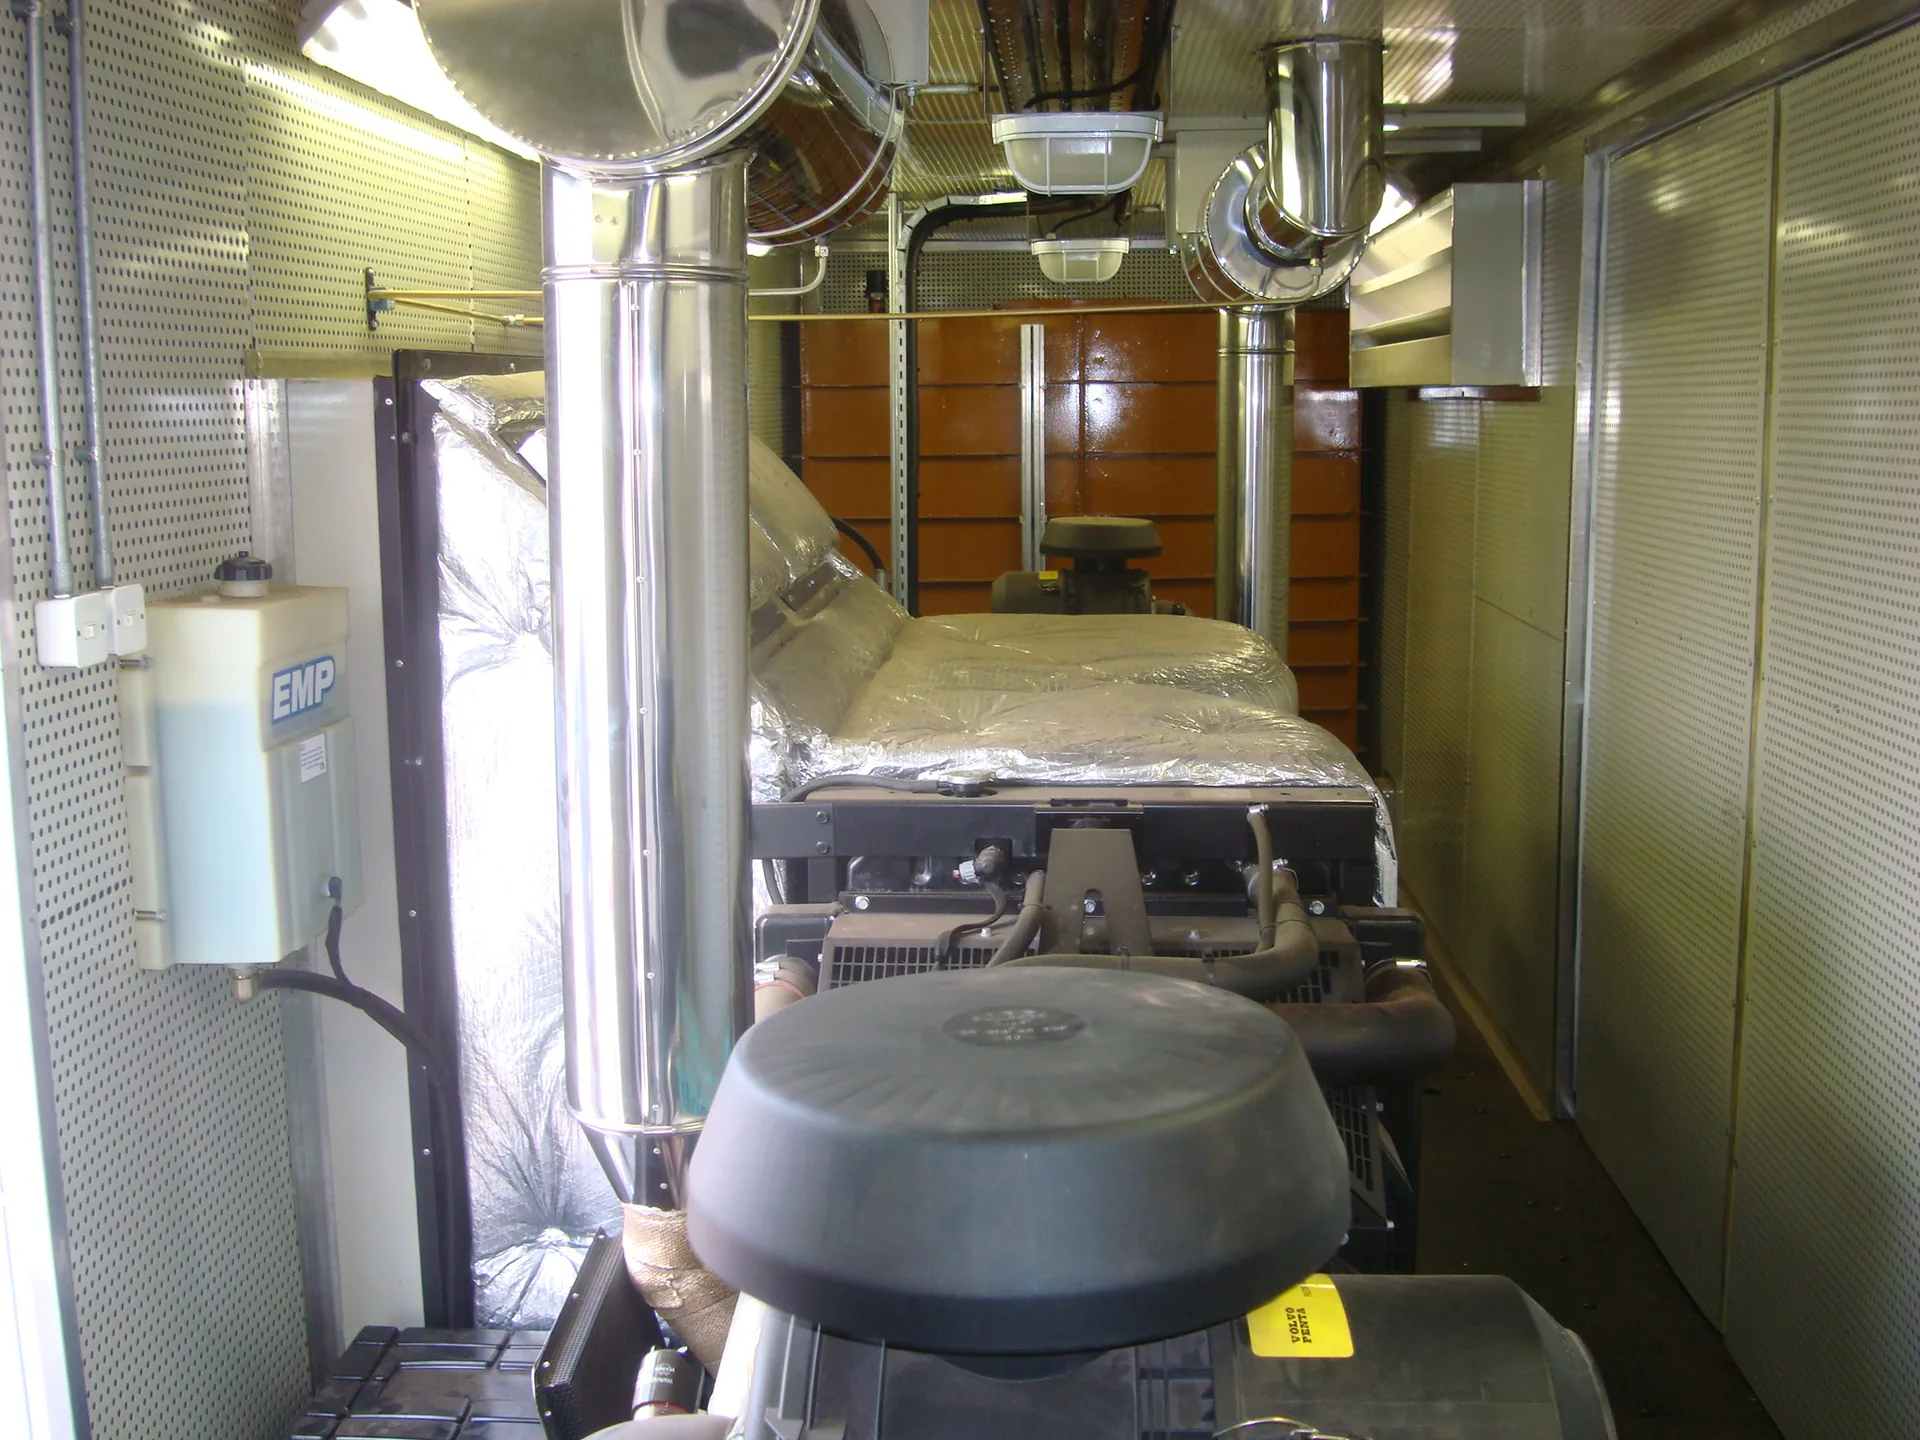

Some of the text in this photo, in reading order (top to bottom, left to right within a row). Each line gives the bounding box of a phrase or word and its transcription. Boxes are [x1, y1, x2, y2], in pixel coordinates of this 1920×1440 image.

[272, 657, 335, 723] EMP
[1285, 1307, 1300, 1344] VOLVO
[1296, 1307, 1312, 1344] PENTA
